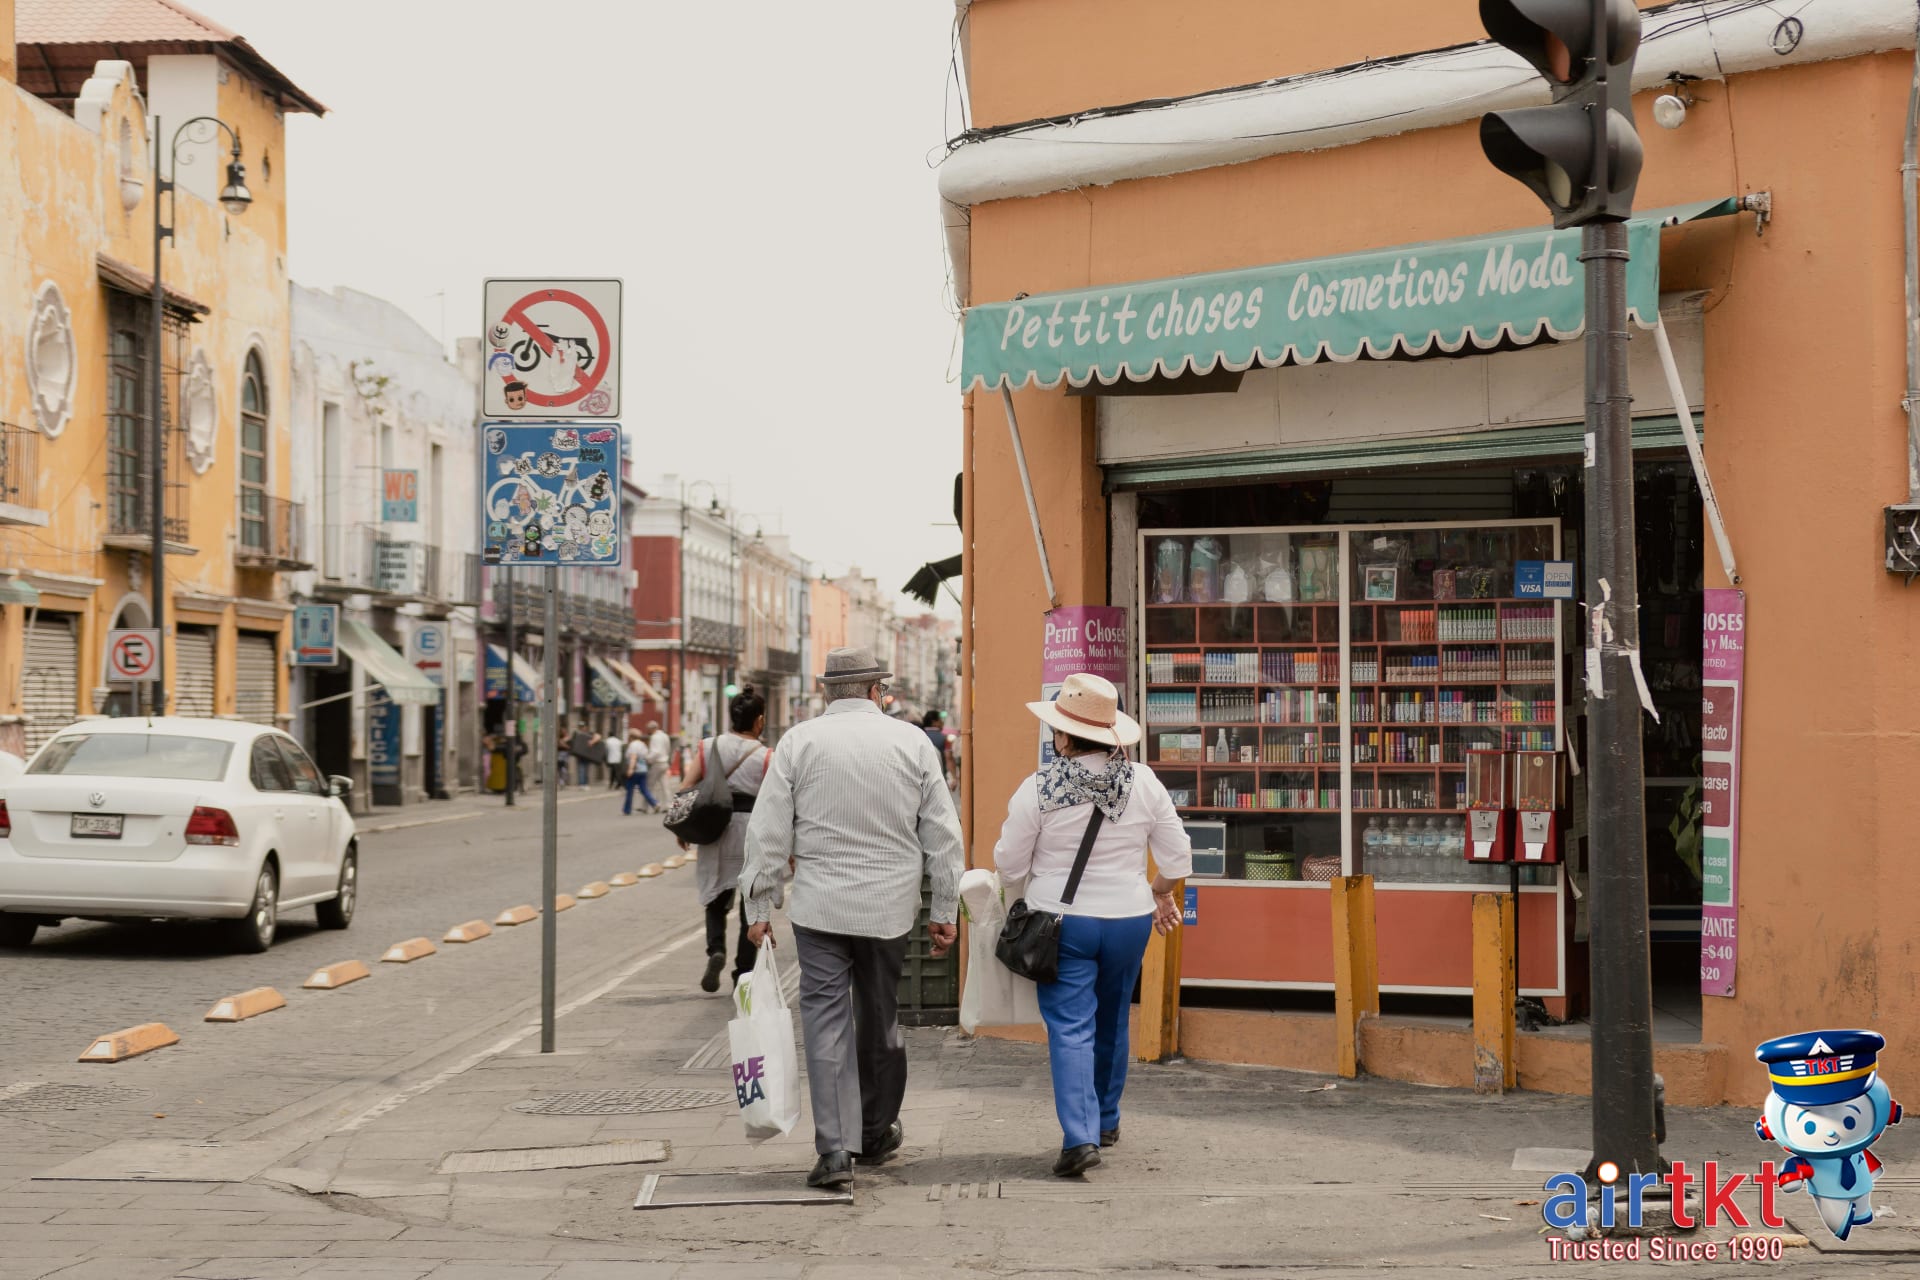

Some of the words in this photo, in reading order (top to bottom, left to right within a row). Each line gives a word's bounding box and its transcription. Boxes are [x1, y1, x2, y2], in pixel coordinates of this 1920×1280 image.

[1001, 293, 1137, 350] Pettit
[1147, 287, 1263, 340] choses
[1288, 257, 1468, 321] Cosmeticos
[1478, 235, 1573, 297] Moda
[384, 471, 416, 501] WC
[1520, 584, 1541, 593] VISA
[421, 632, 436, 649] E
[1711, 638, 1717, 653] y
[123, 642, 143, 668] E
[733, 1056, 764, 1086] PUE
[736, 1078, 765, 1108] BLA
